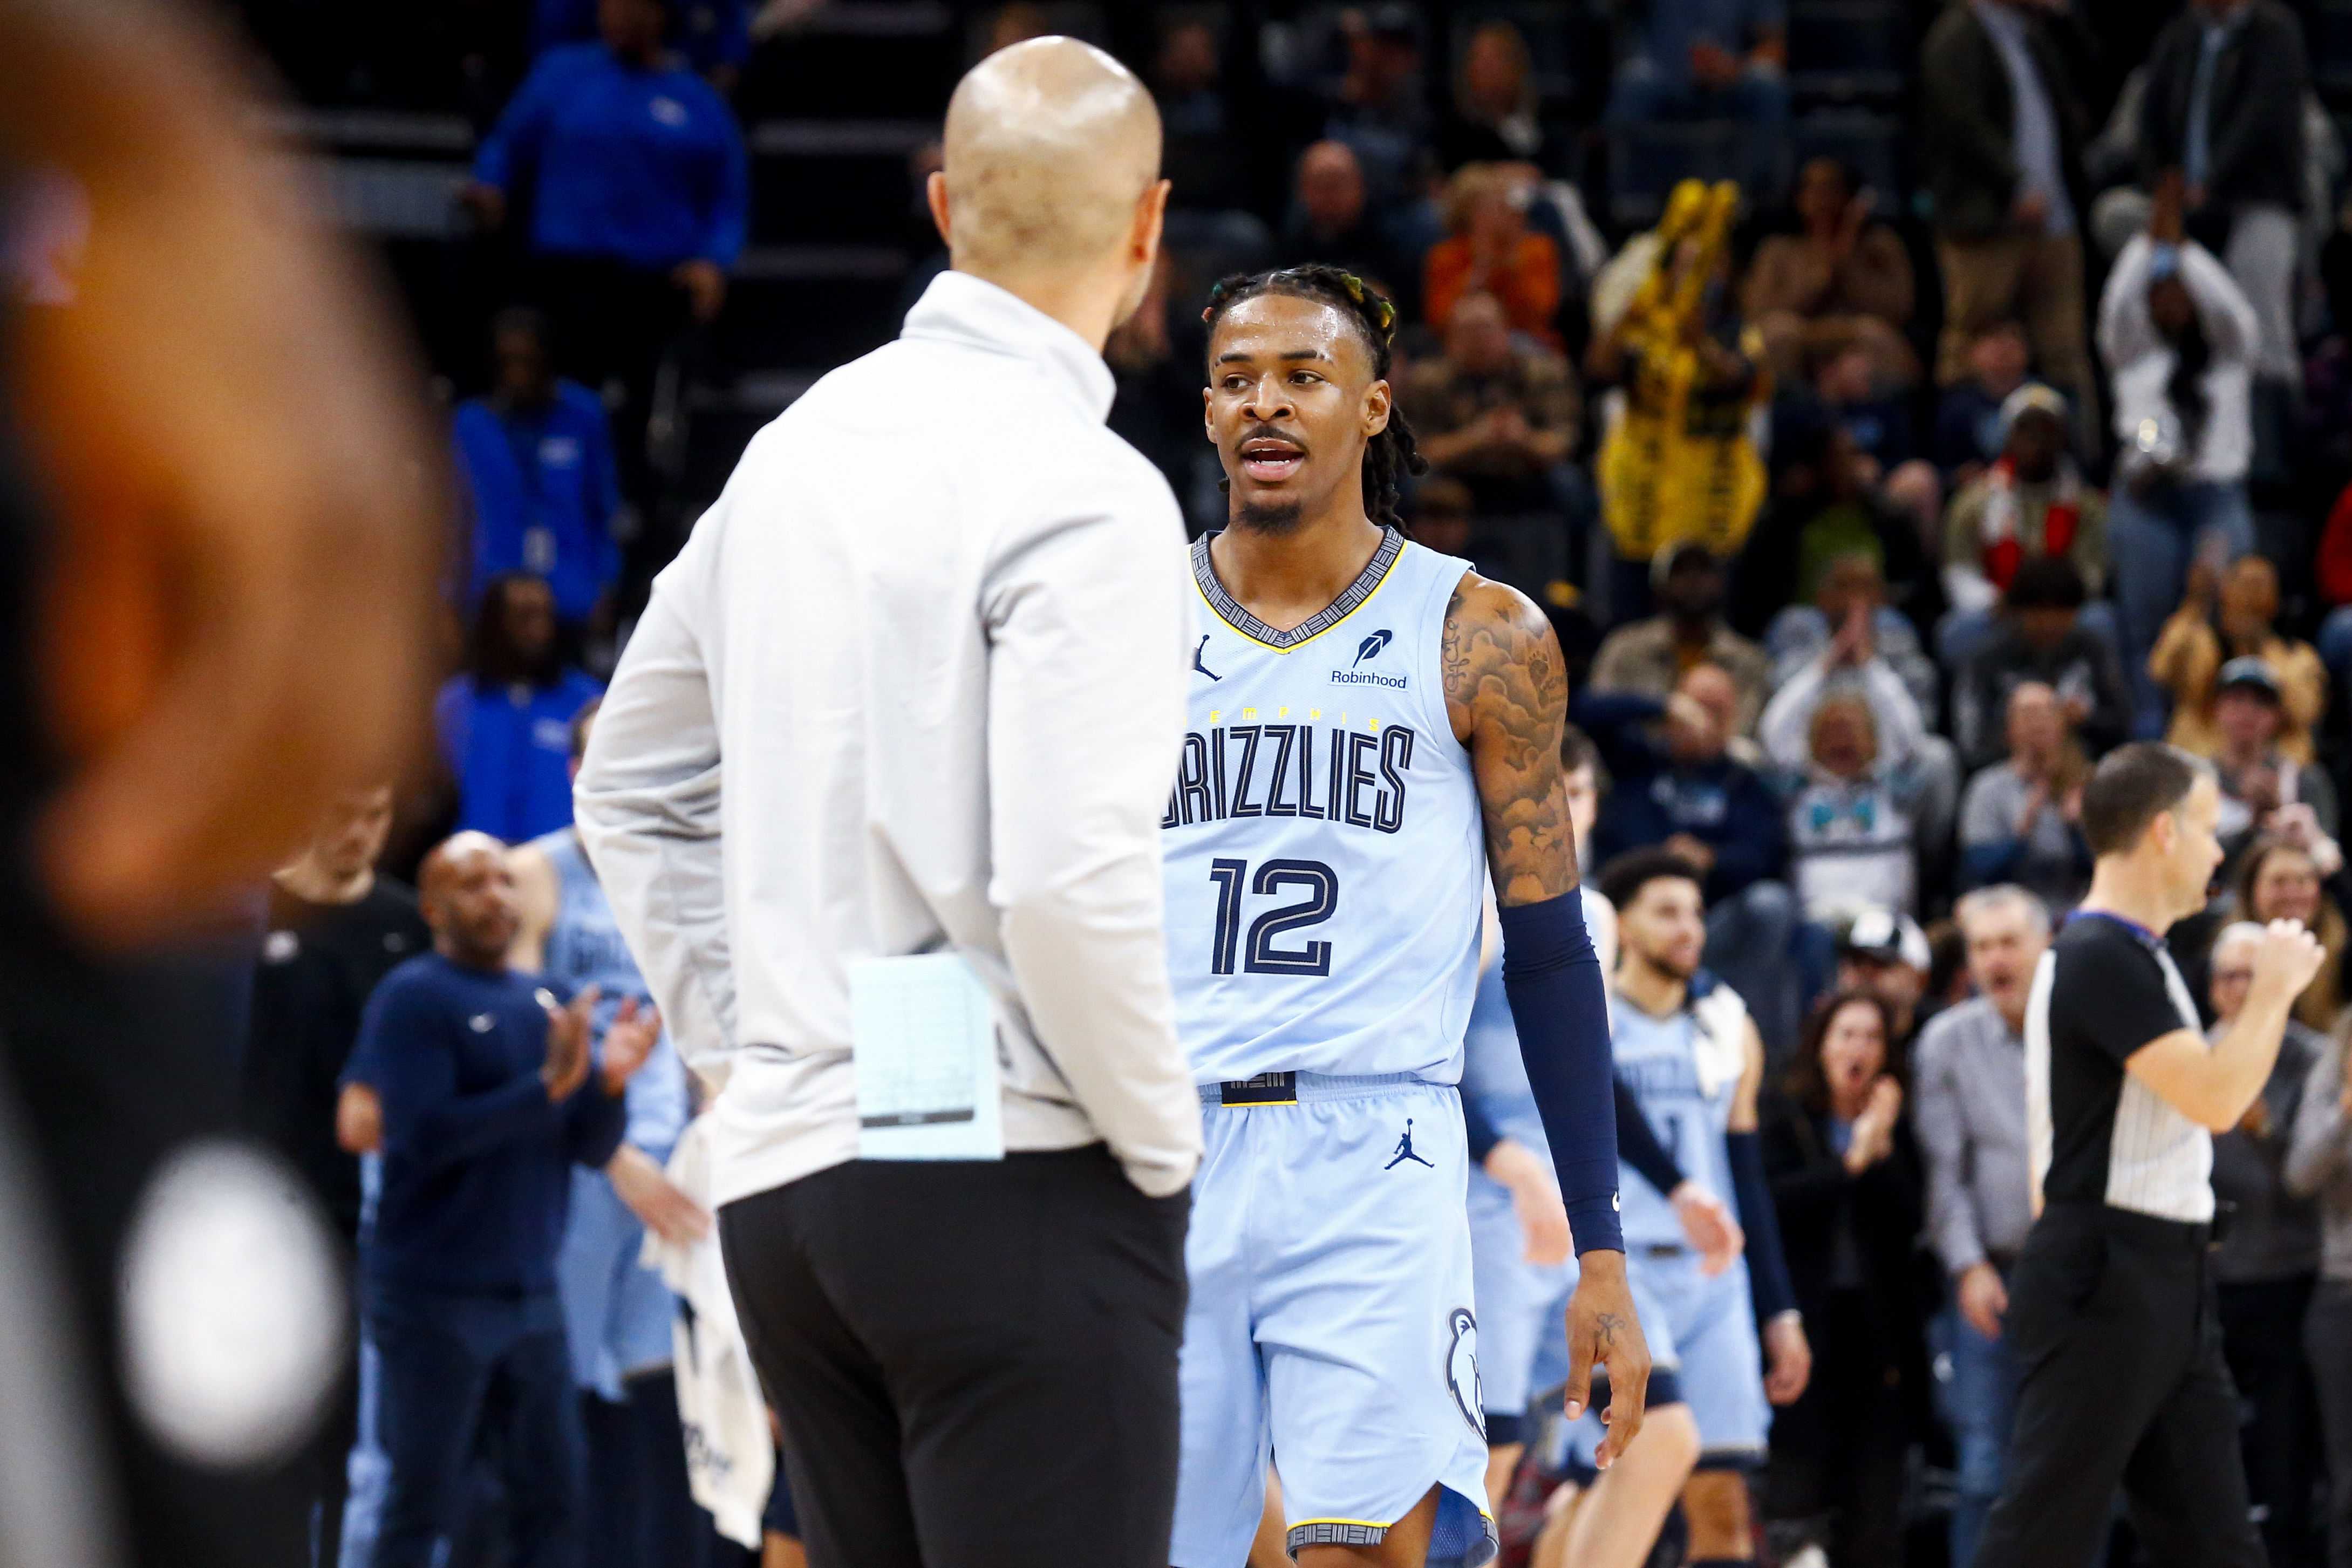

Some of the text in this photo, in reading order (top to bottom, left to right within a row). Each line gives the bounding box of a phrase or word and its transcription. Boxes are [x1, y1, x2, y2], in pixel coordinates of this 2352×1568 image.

[1331, 670, 1407, 689] Robinhood
[1183, 706, 1380, 732] EMPHIS
[1209, 857, 1339, 977] 12
